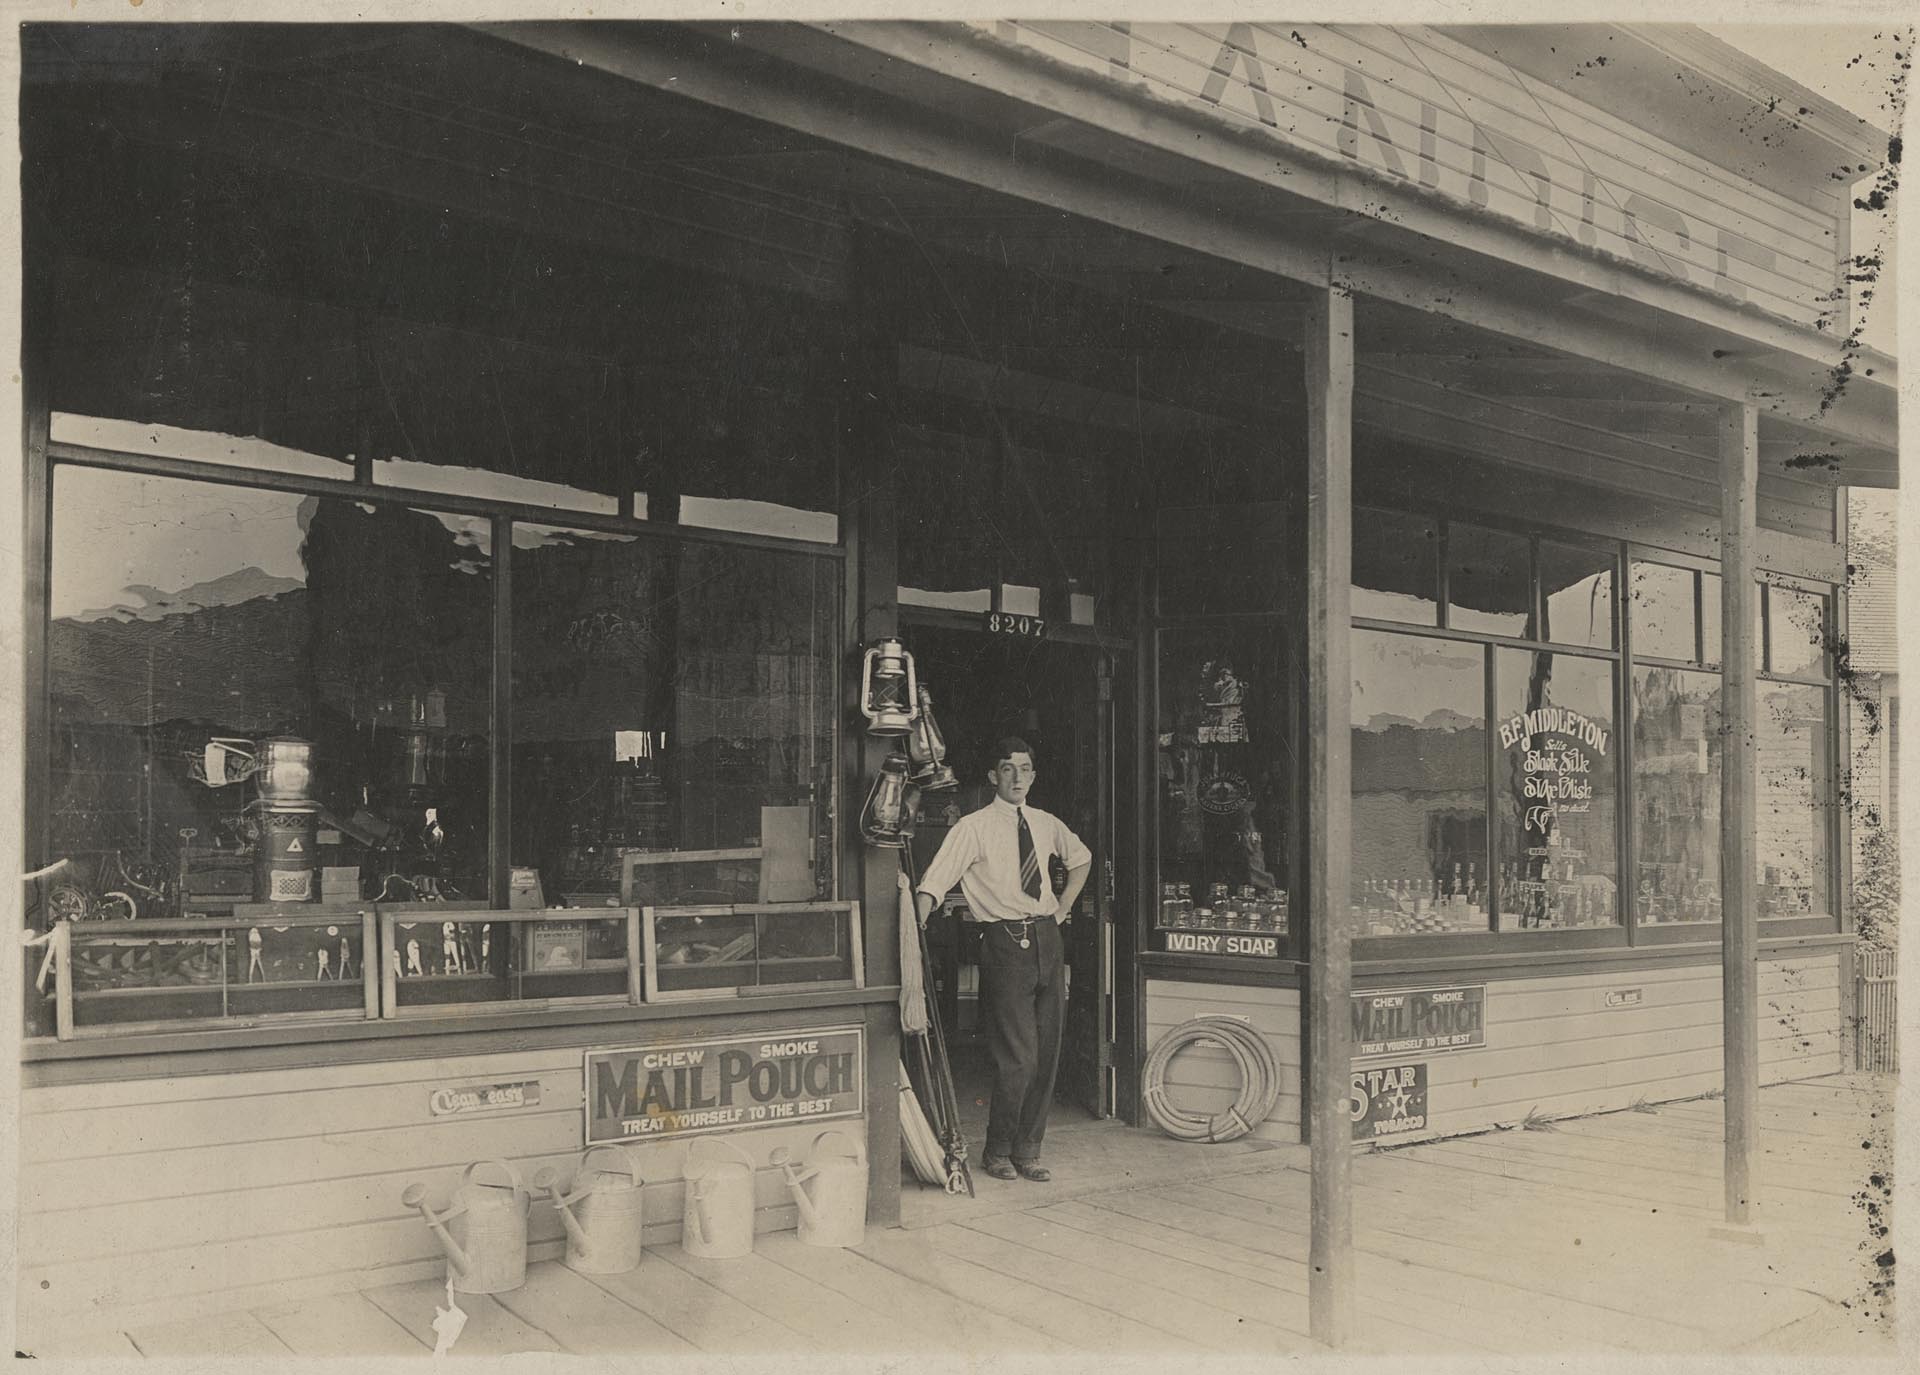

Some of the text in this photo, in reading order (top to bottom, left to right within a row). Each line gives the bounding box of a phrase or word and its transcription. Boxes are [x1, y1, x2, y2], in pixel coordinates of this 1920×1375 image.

[989, 614, 1044, 636] 8207
[1521, 708, 1608, 756] MIDDLETON
[1545, 739, 1568, 750] Sells
[1524, 748, 1591, 776] Black Silk
[1168, 934, 1277, 955] IVORY SOAP
[1373, 991, 1464, 1008] CHEW SMOKE
[1351, 996, 1482, 1043] MAIL POUCH
[643, 1041, 819, 1069] CHEW SMOKE
[1361, 1033, 1471, 1054] TREAT YOURSELF TO THE BEST
[595, 1049, 854, 1120] MAIL POUCH
[1350, 1066, 1416, 1122] STAR
[622, 1098, 833, 1134] TREAT YOURSELF TO THE BEST
[1374, 1115, 1425, 1134] TOBACCO
